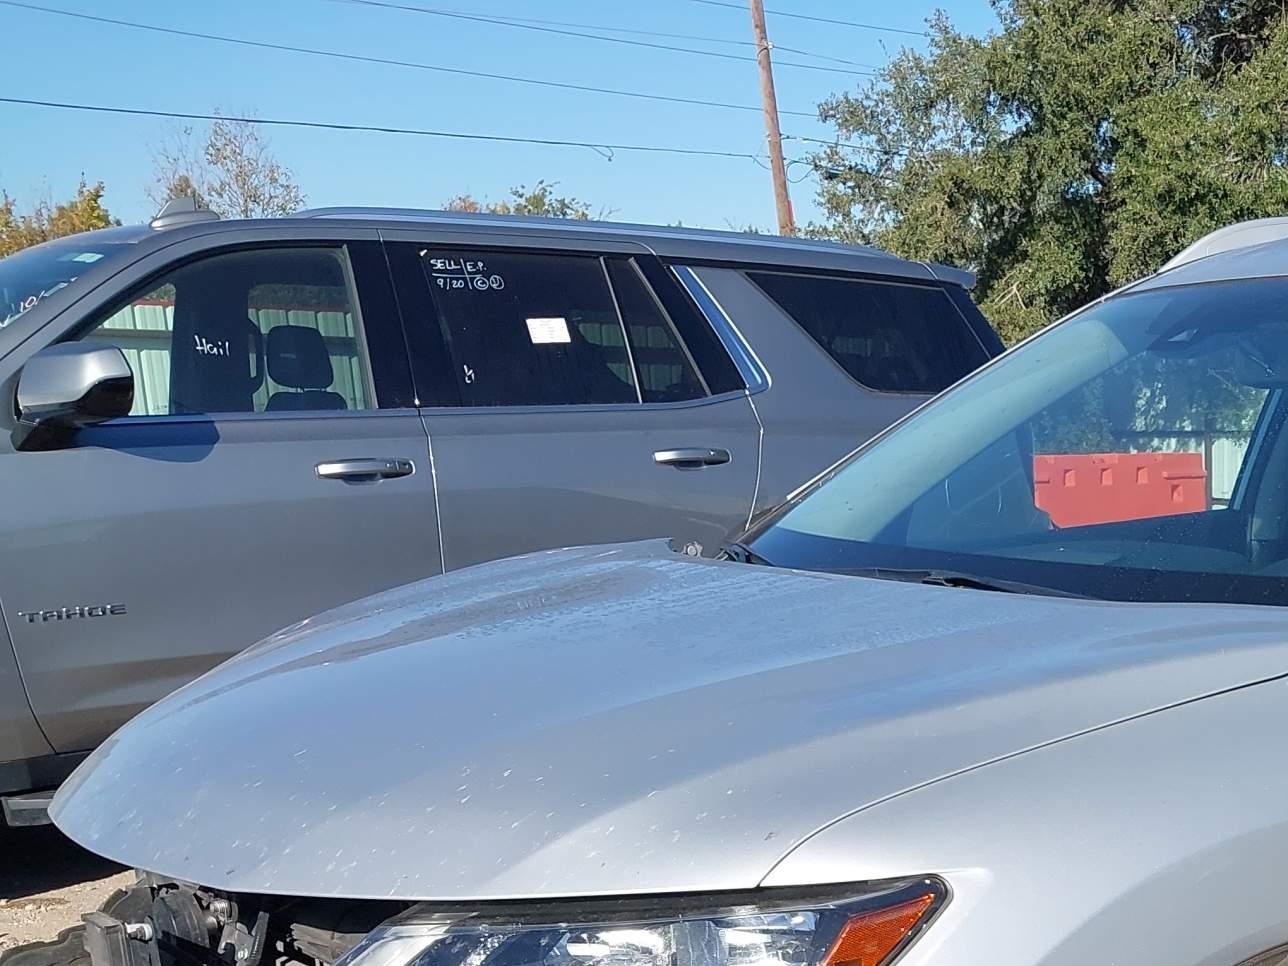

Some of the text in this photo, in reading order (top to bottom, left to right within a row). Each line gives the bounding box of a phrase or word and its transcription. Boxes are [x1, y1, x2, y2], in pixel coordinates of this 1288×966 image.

[430, 259, 461, 270] SELL
[437, 278, 464, 290] 9/20
[194, 334, 230, 357] Hail
[18, 603, 128, 623] TAHOE
